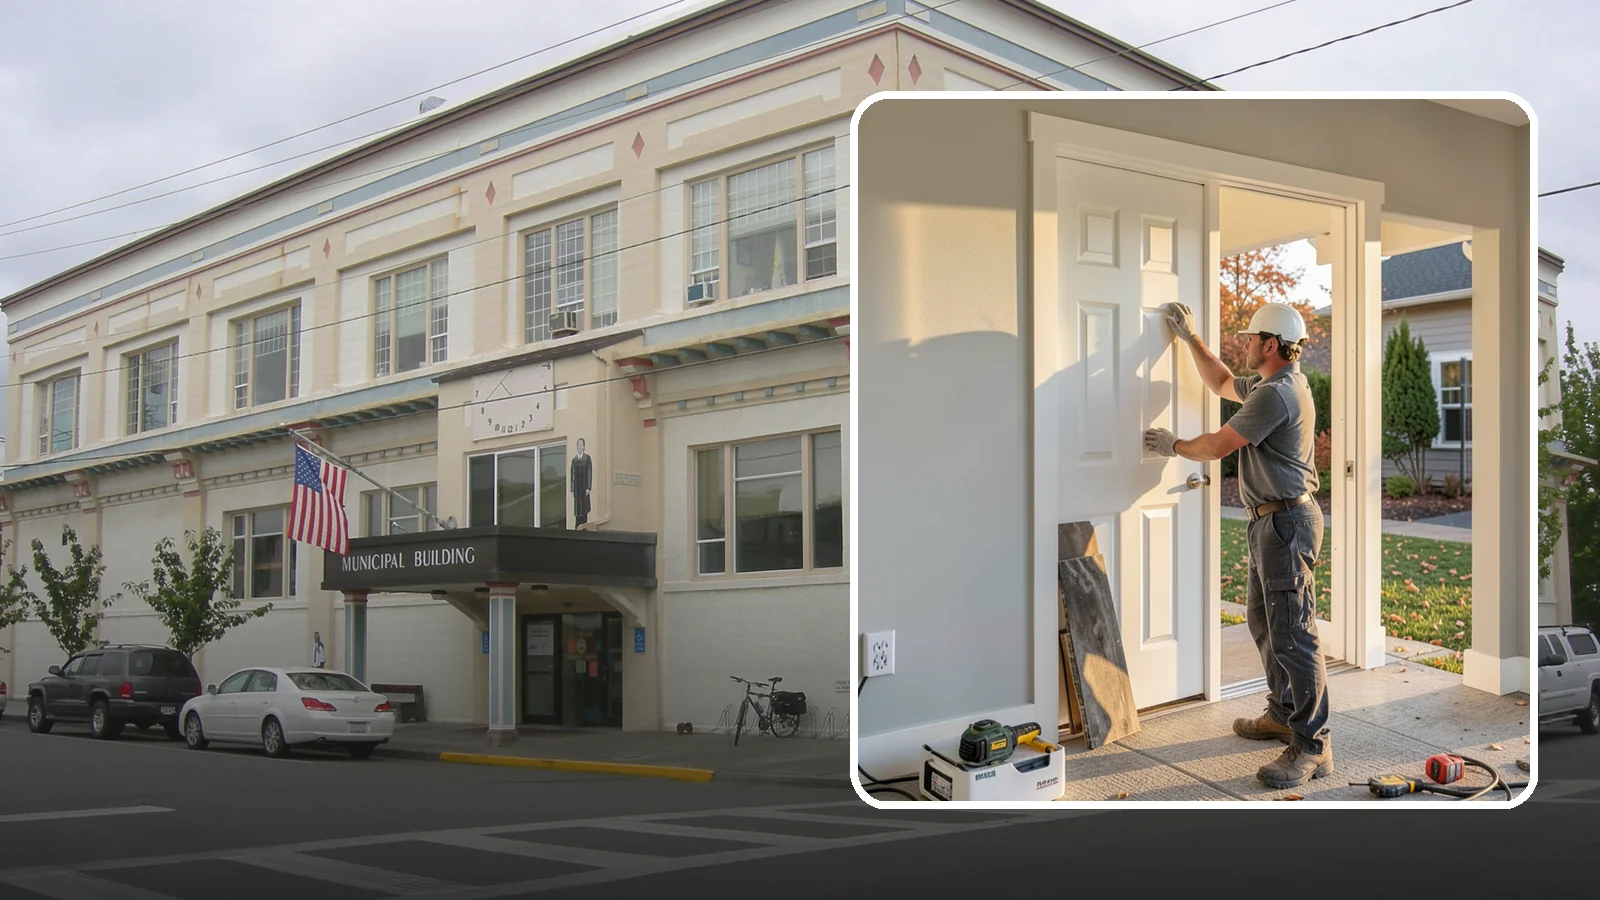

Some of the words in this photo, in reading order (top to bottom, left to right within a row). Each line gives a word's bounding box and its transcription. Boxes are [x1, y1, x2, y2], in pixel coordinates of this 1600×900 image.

[475, 390, 479, 398] 7
[481, 407, 485, 415] 8
[495, 424, 500, 432] 10
[502, 425, 506, 433] 11
[508, 425, 513, 433] 12
[529, 414, 533, 422] 3
[536, 402, 540, 410] 4
[342, 552, 405, 572] MUNICIPAL
[414, 546, 475, 567] BUILDING
